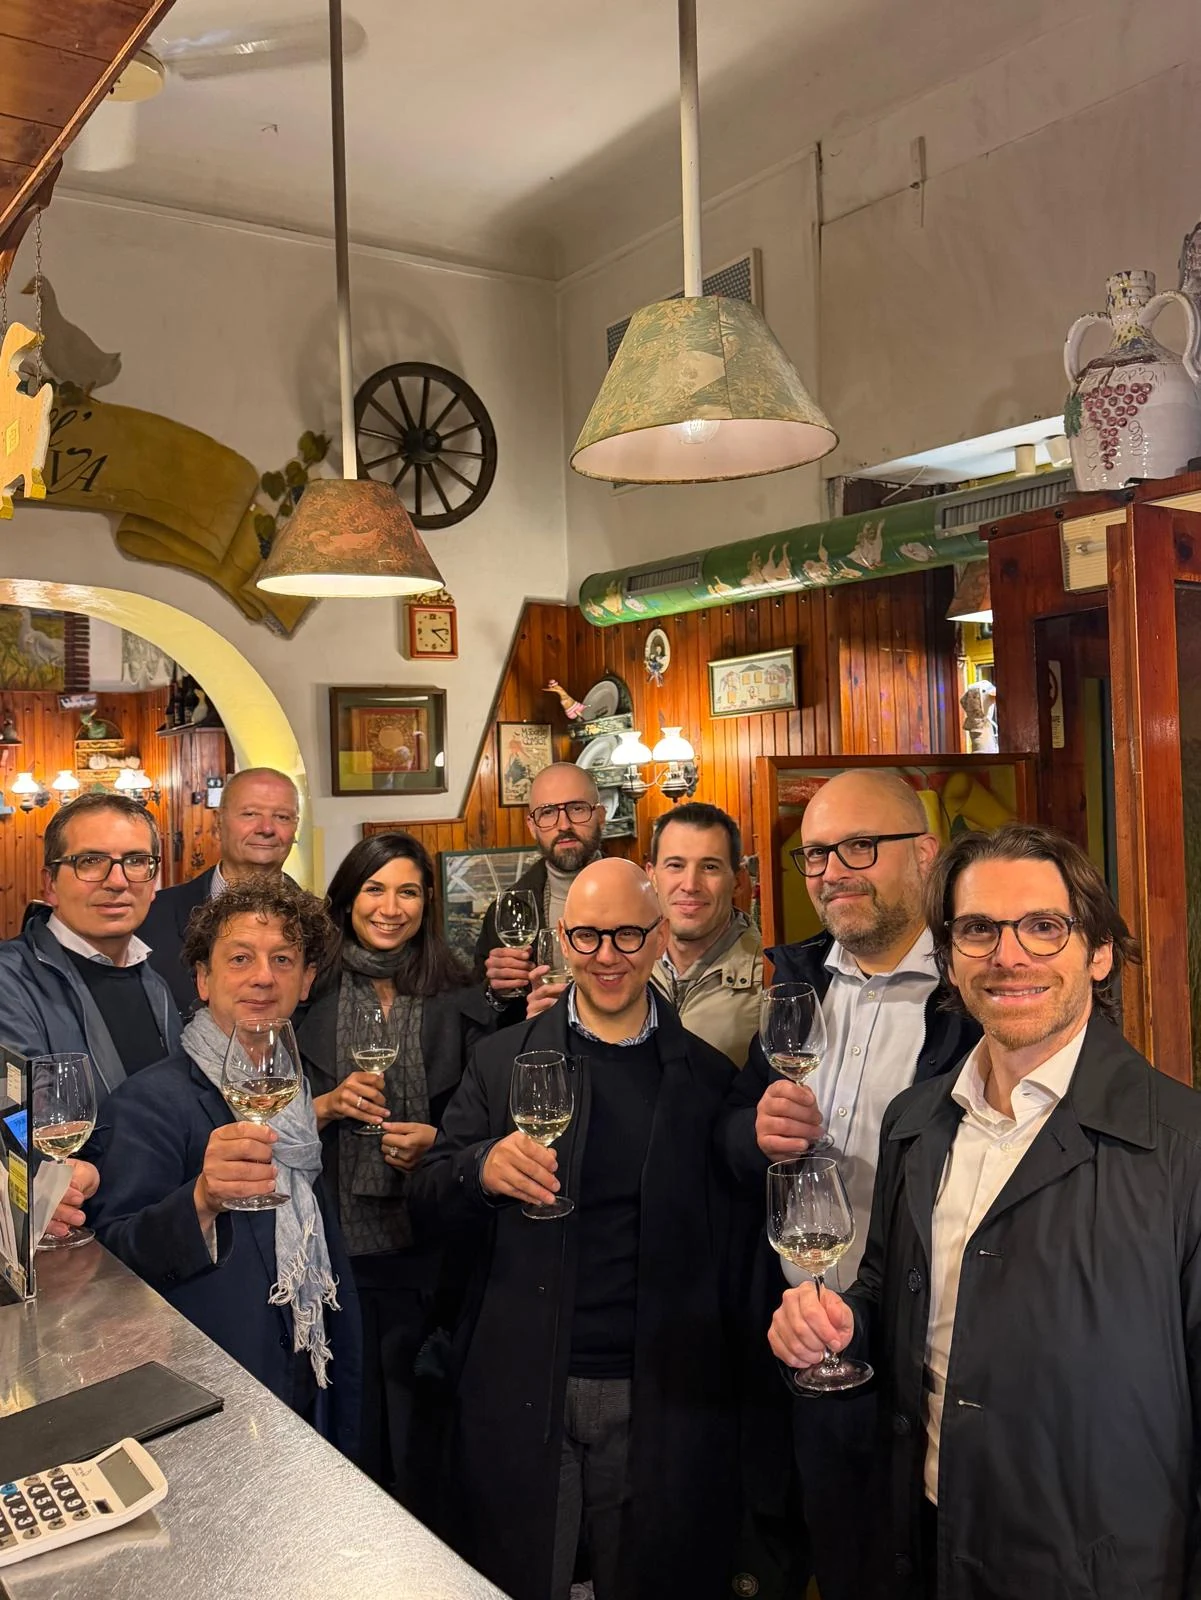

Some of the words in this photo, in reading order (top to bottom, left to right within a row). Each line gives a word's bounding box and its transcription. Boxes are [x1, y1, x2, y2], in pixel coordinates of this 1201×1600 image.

[53, 1476, 69, 1485] 7
[30, 1486, 45, 1494] 4
[60, 1487, 75, 1496] 8
[6, 1494, 21, 1502] 1
[36, 1496, 52, 1505] 5
[67, 1498, 82, 1507] 9
[11, 1505, 27, 1514] 2
[42, 1507, 58, 1517] 6
[18, 1516, 33, 1525] 3
